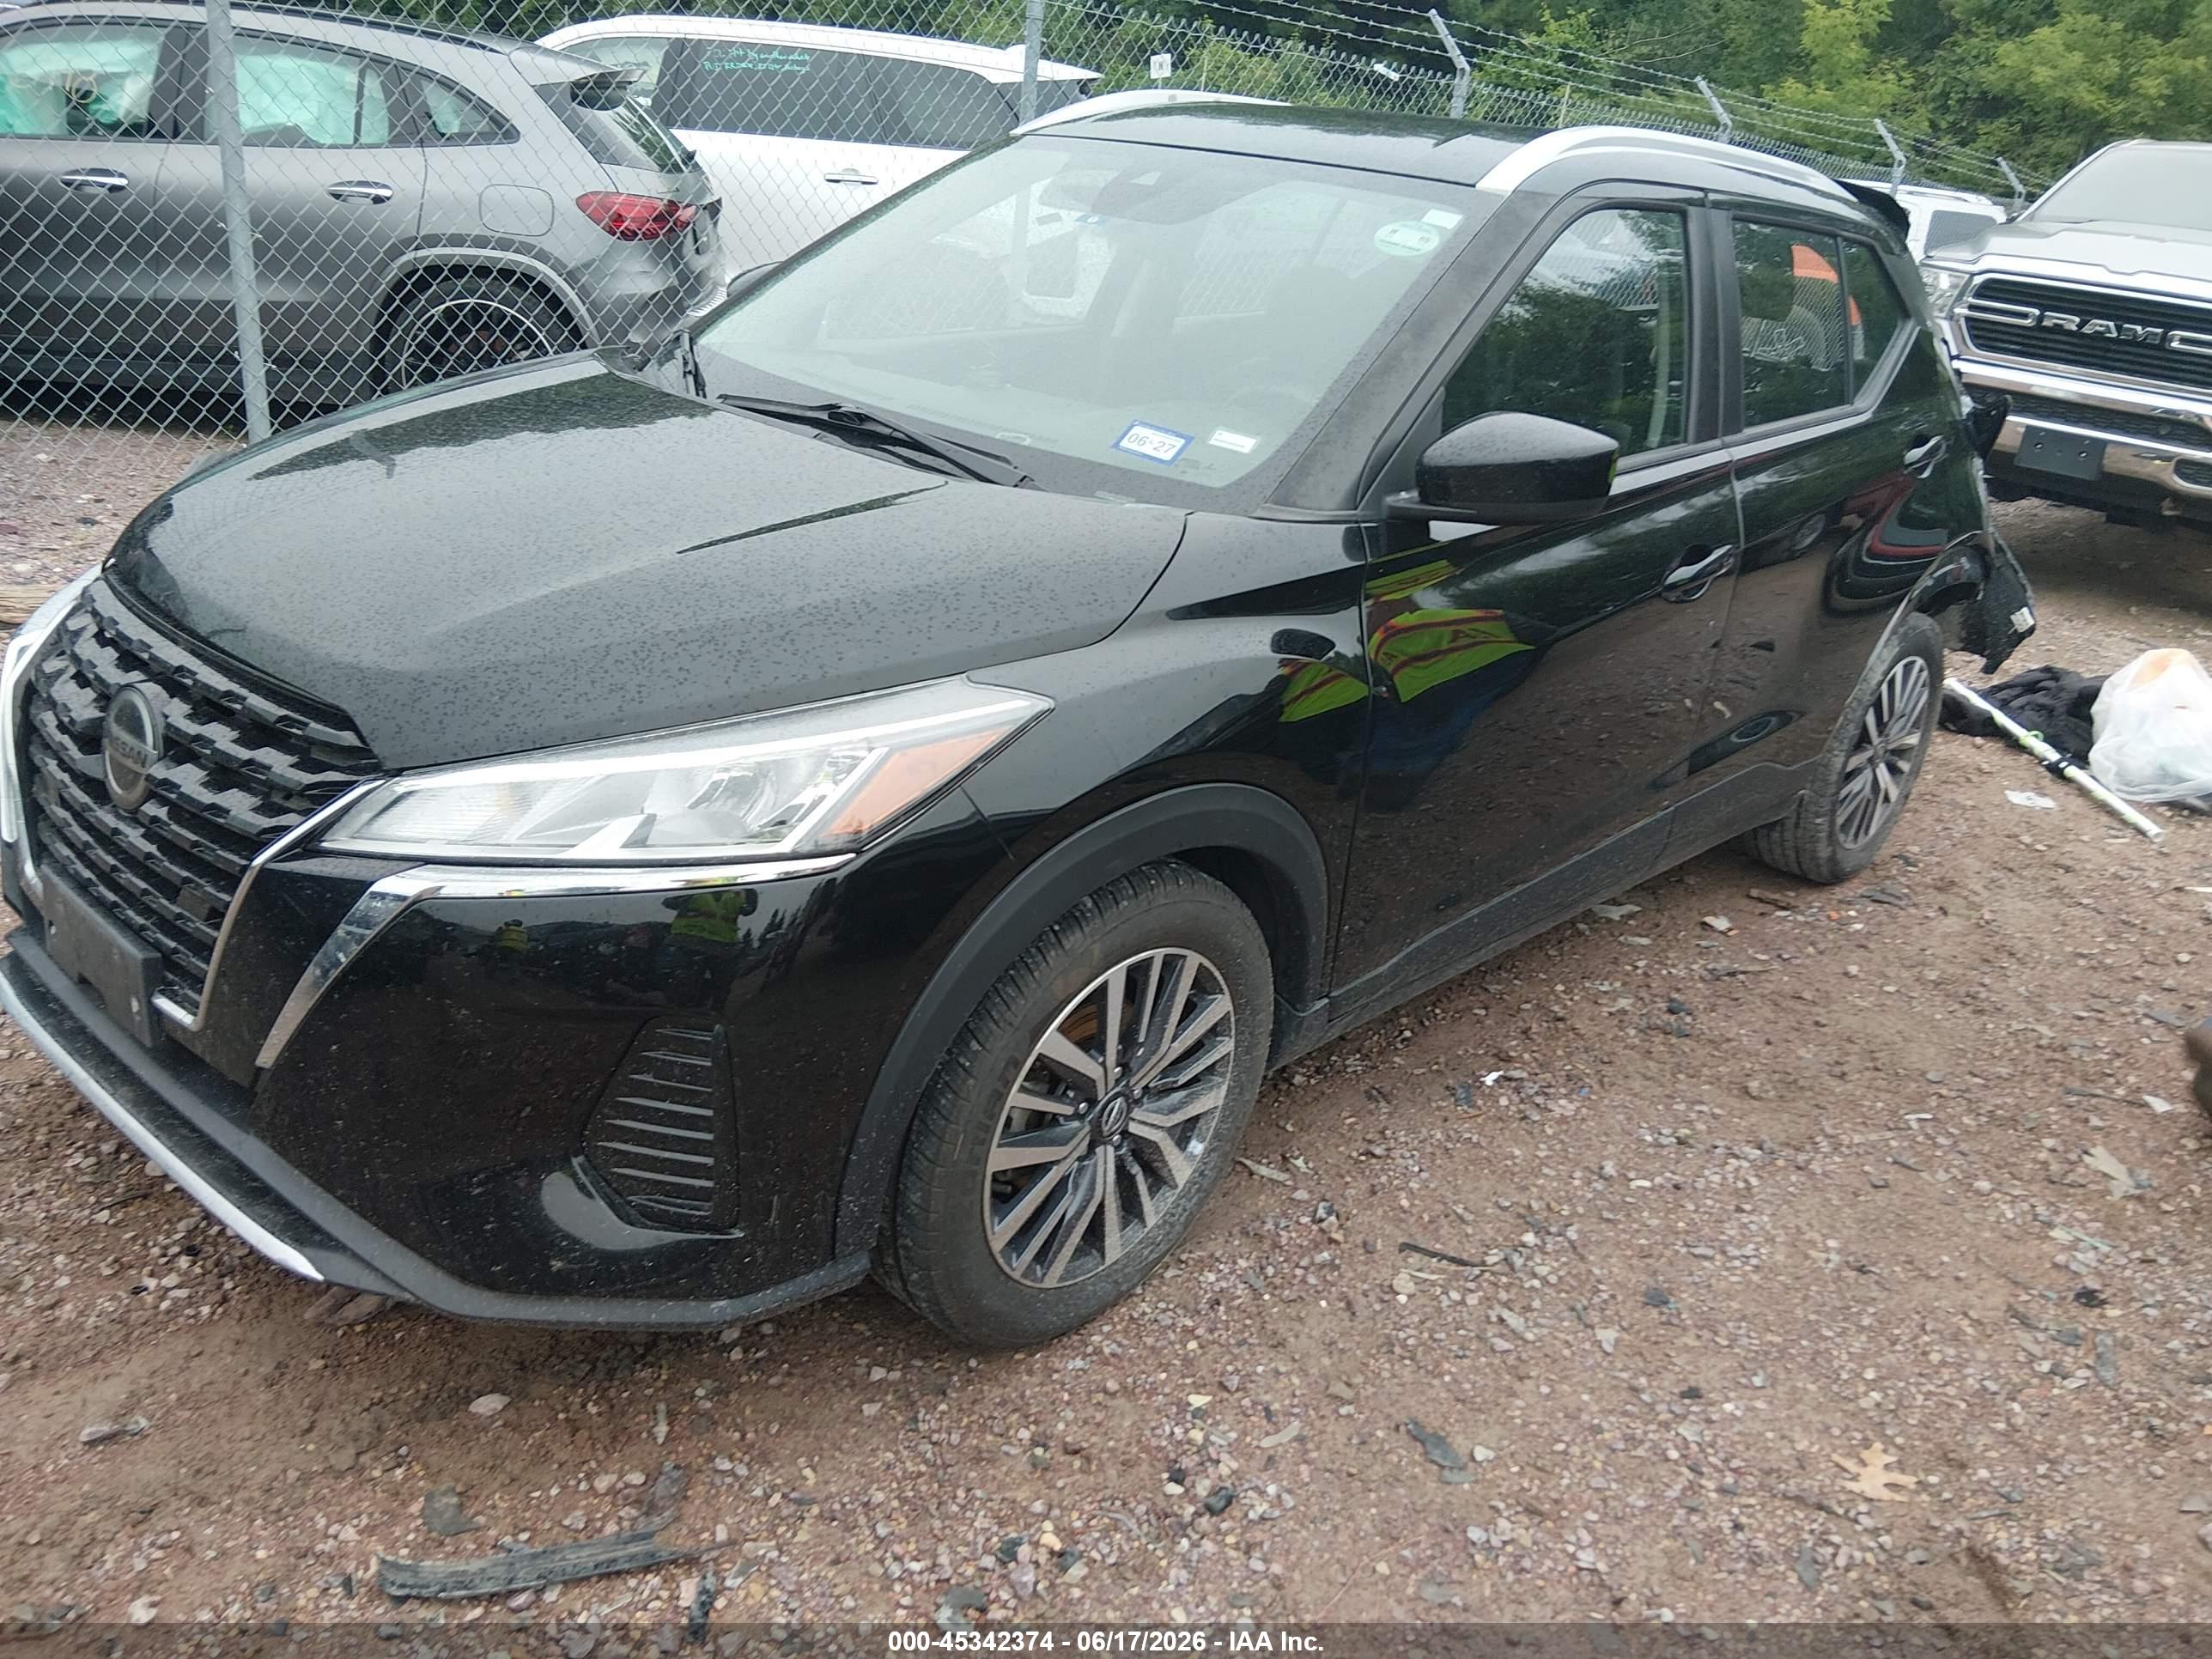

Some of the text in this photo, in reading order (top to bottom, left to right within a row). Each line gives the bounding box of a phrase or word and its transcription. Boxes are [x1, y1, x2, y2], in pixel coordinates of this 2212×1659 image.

[2041, 311, 2164, 344] RAM
[1127, 433, 1149, 447] 06
[1153, 441, 1176, 453] 27
